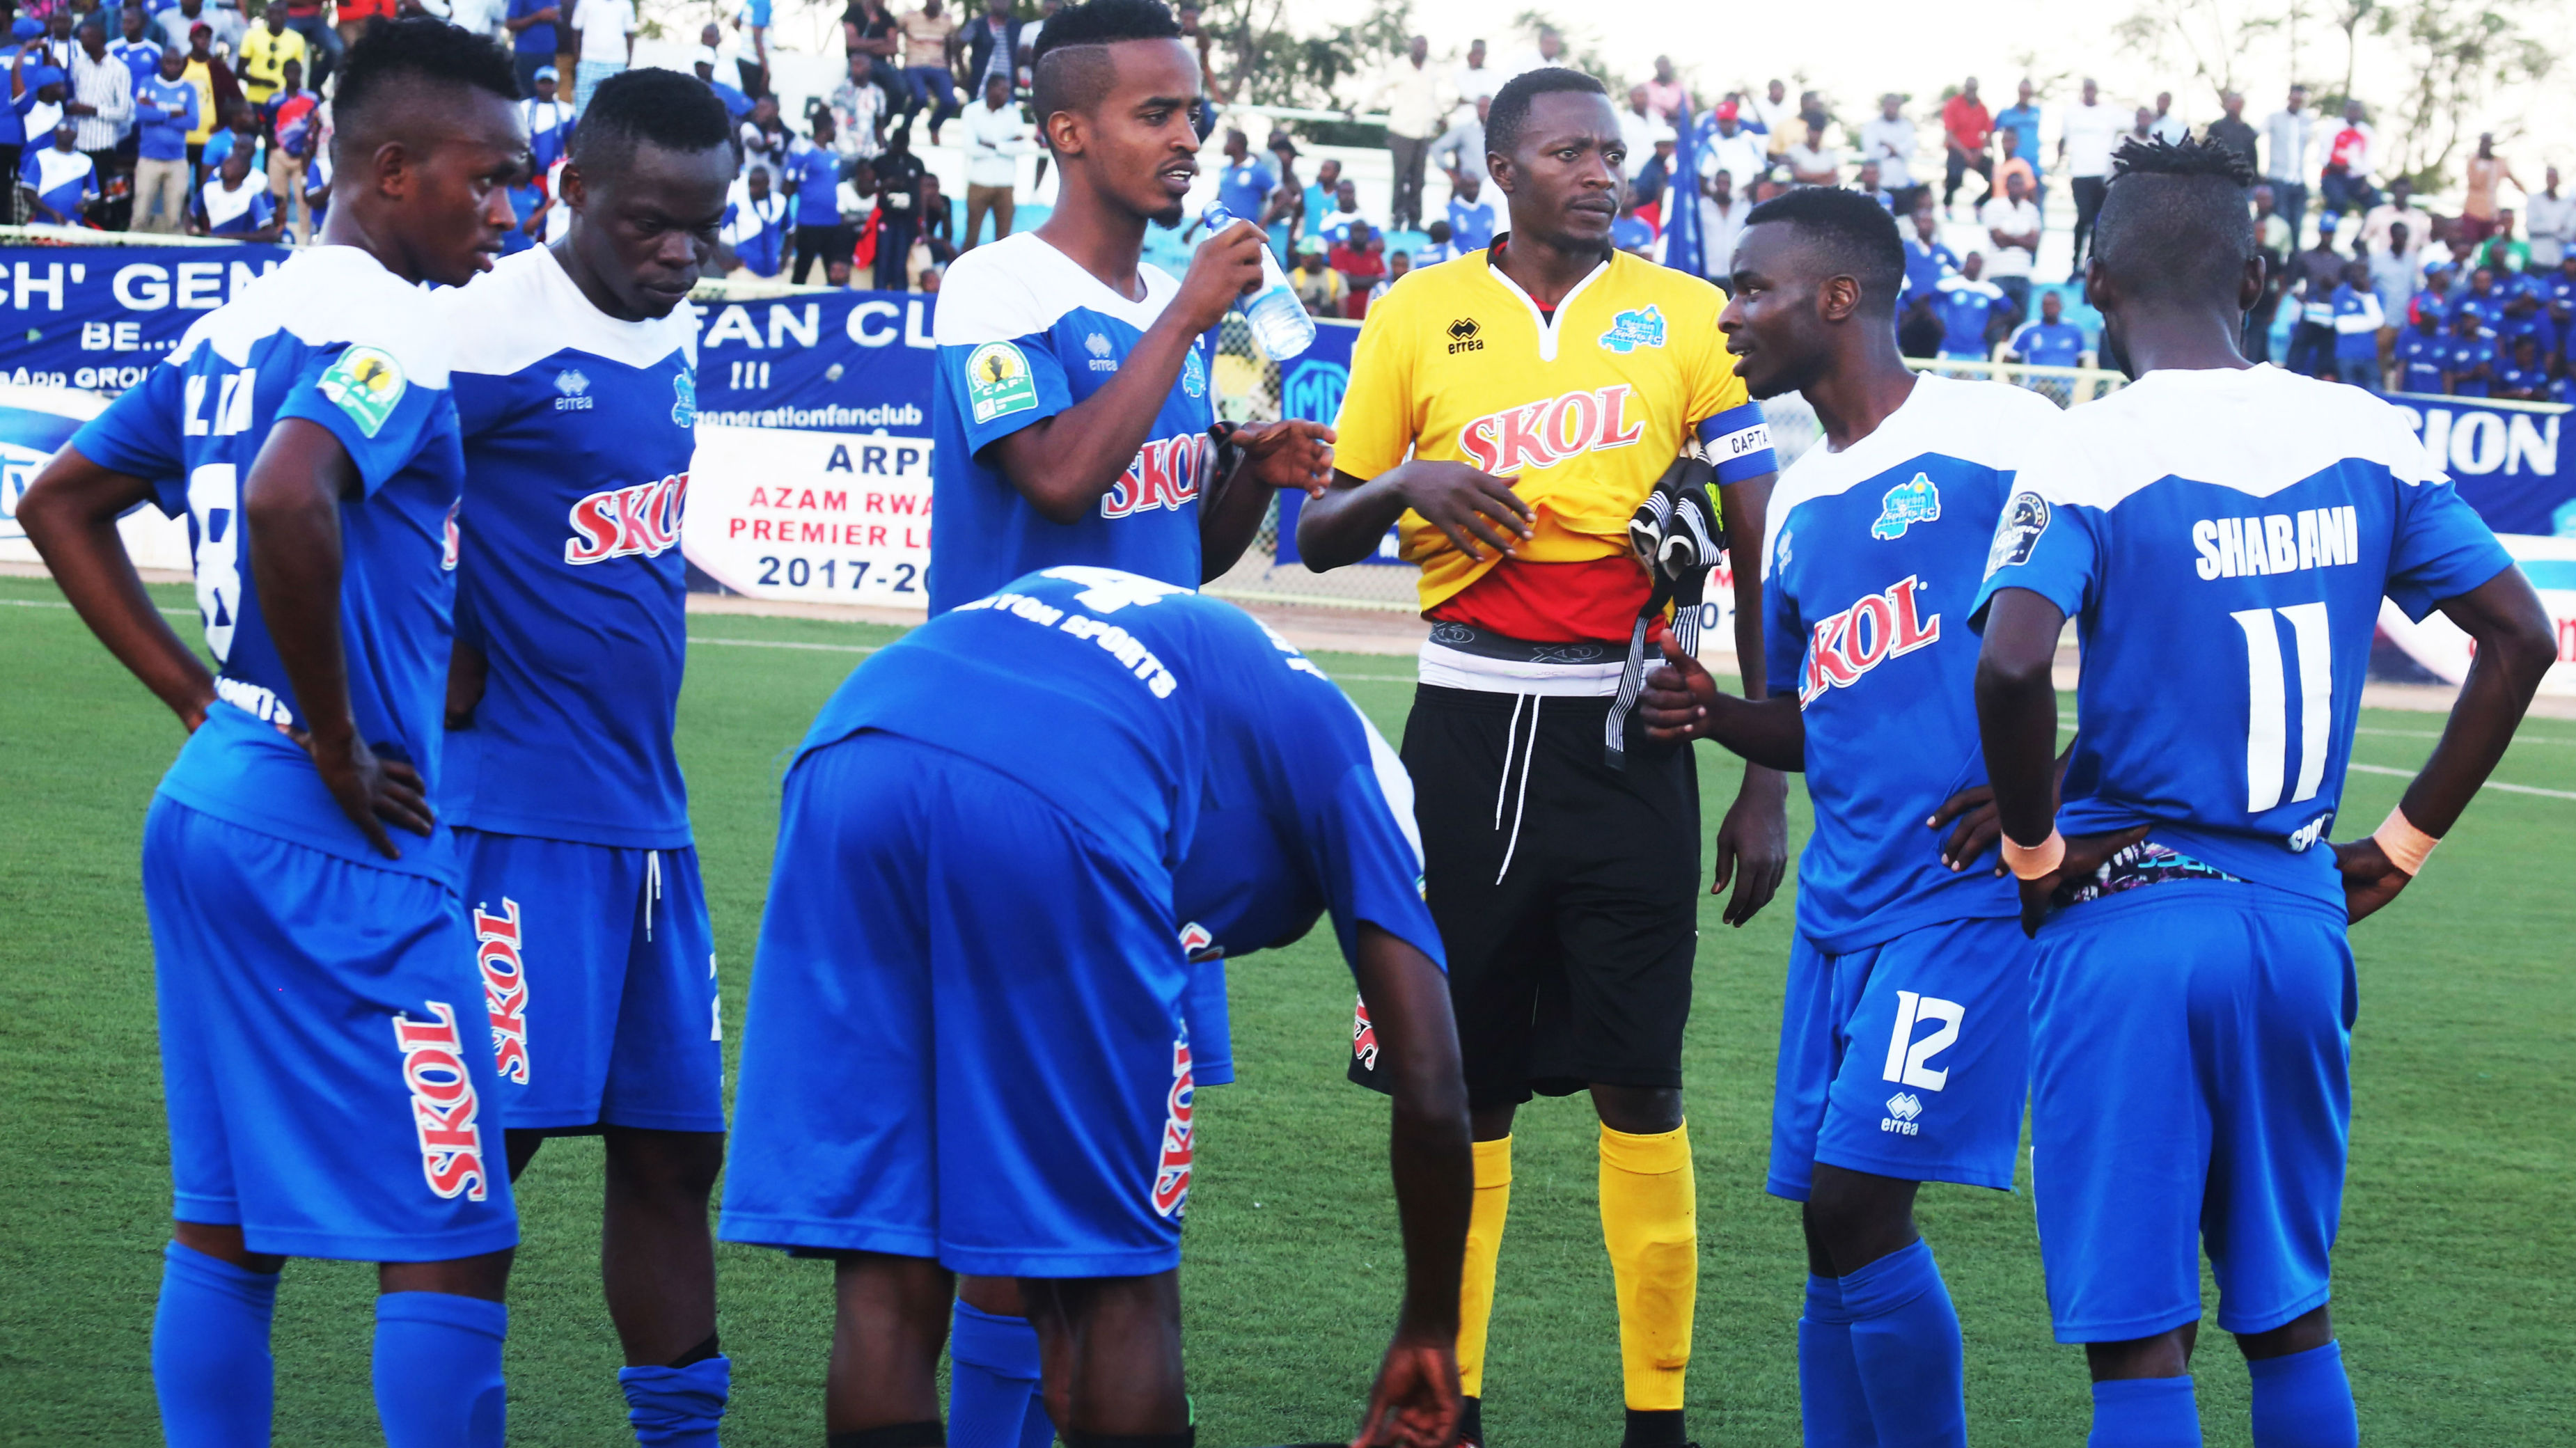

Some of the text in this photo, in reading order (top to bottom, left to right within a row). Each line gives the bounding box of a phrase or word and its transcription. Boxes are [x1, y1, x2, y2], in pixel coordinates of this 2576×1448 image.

[0, 261, 86, 311] H'
[1448, 339, 1484, 354] errea
[825, 443, 934, 478] ARP
[1459, 384, 1646, 475] SKOL
[2394, 405, 2561, 477] ION
[729, 518, 932, 549] PREMIER L
[748, 486, 847, 512] AZAM
[757, 556, 930, 593] 2017-2
[2192, 505, 2359, 581] SHABANI
[1059, 610, 1177, 699] SPORTS
[2229, 601, 2332, 813] 11
[474, 897, 529, 1085] SKOL
[1882, 990, 1966, 1092] 12
[392, 1000, 487, 1202] SKOL
[1880, 1117, 1919, 1136] errea
